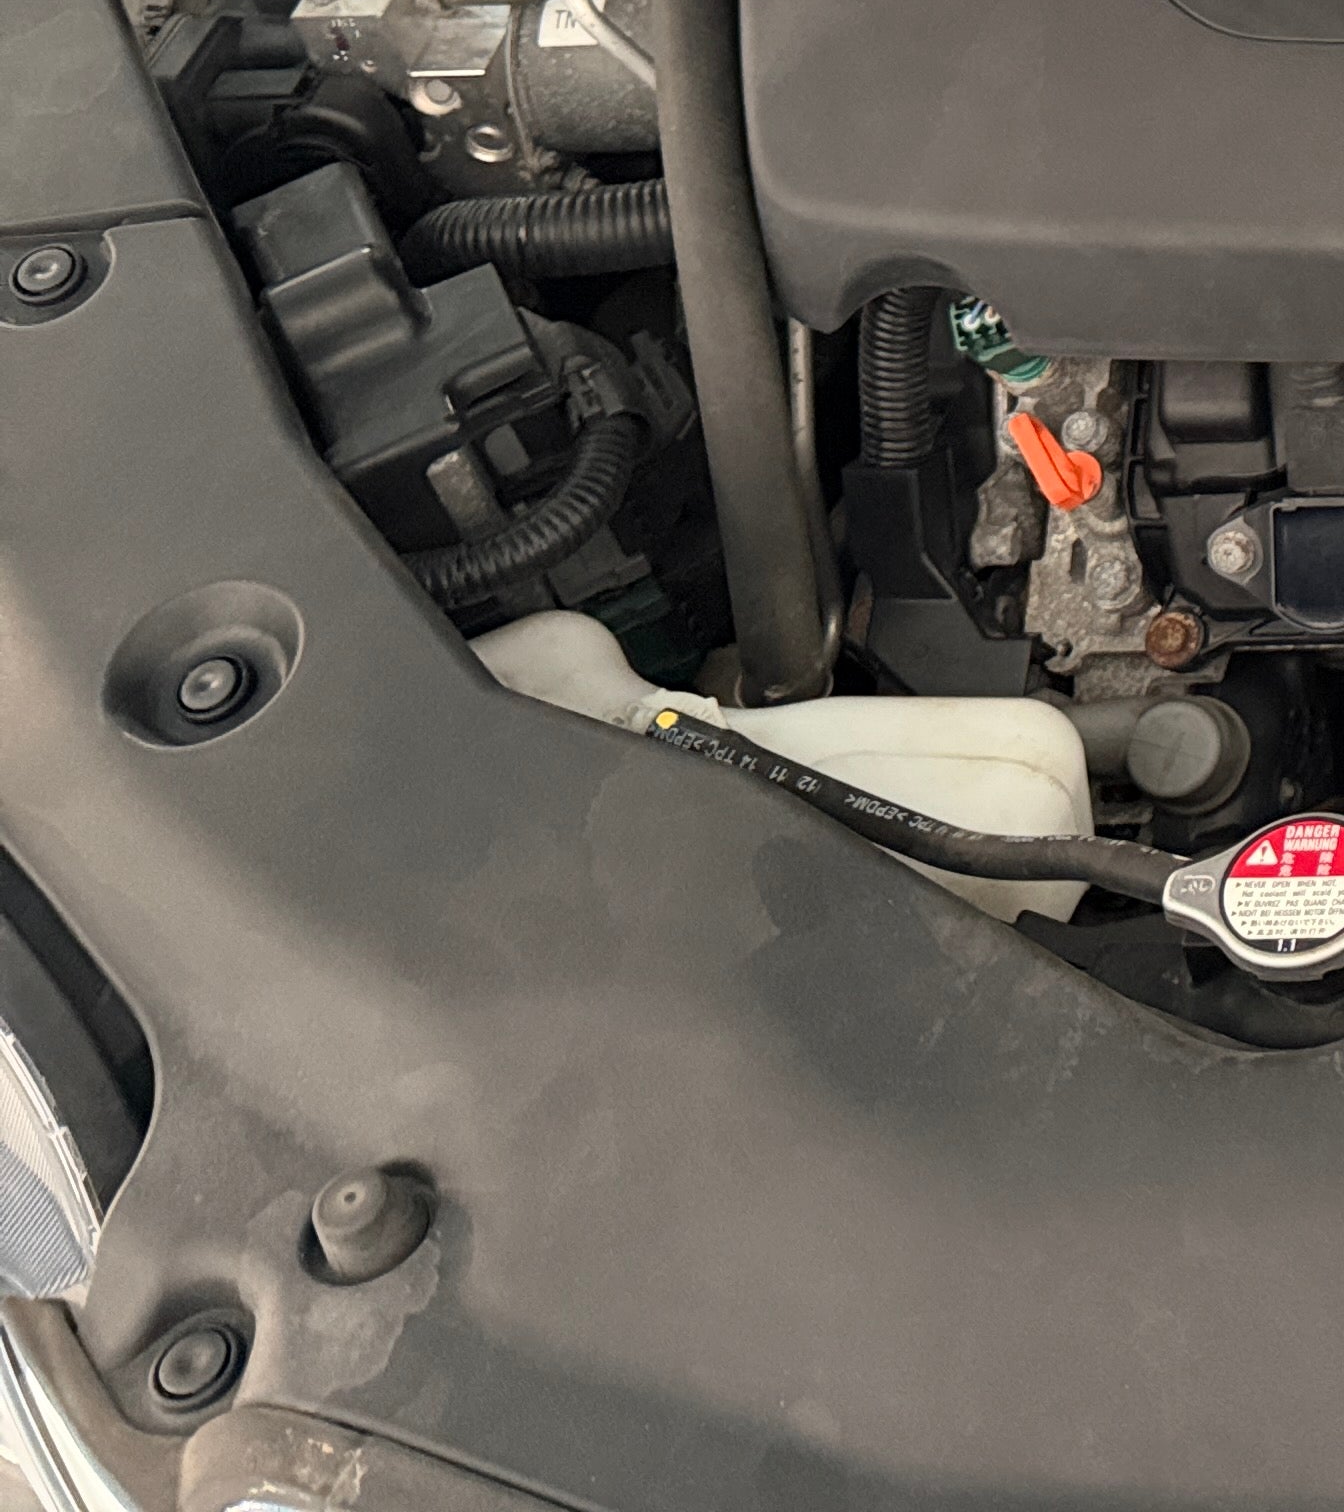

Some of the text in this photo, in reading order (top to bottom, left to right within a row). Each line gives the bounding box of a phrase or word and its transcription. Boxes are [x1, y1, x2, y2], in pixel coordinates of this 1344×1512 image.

[705, 740, 736, 765] TPC
[844, 793, 906, 822] >EPDM<
[1285, 825, 1341, 838] DANGER
[1297, 879, 1316, 888] WHEN
[1286, 899, 1299, 907] PAS
[1303, 899, 1328, 907] QUAND
[1277, 938, 1296, 952] 1.1
